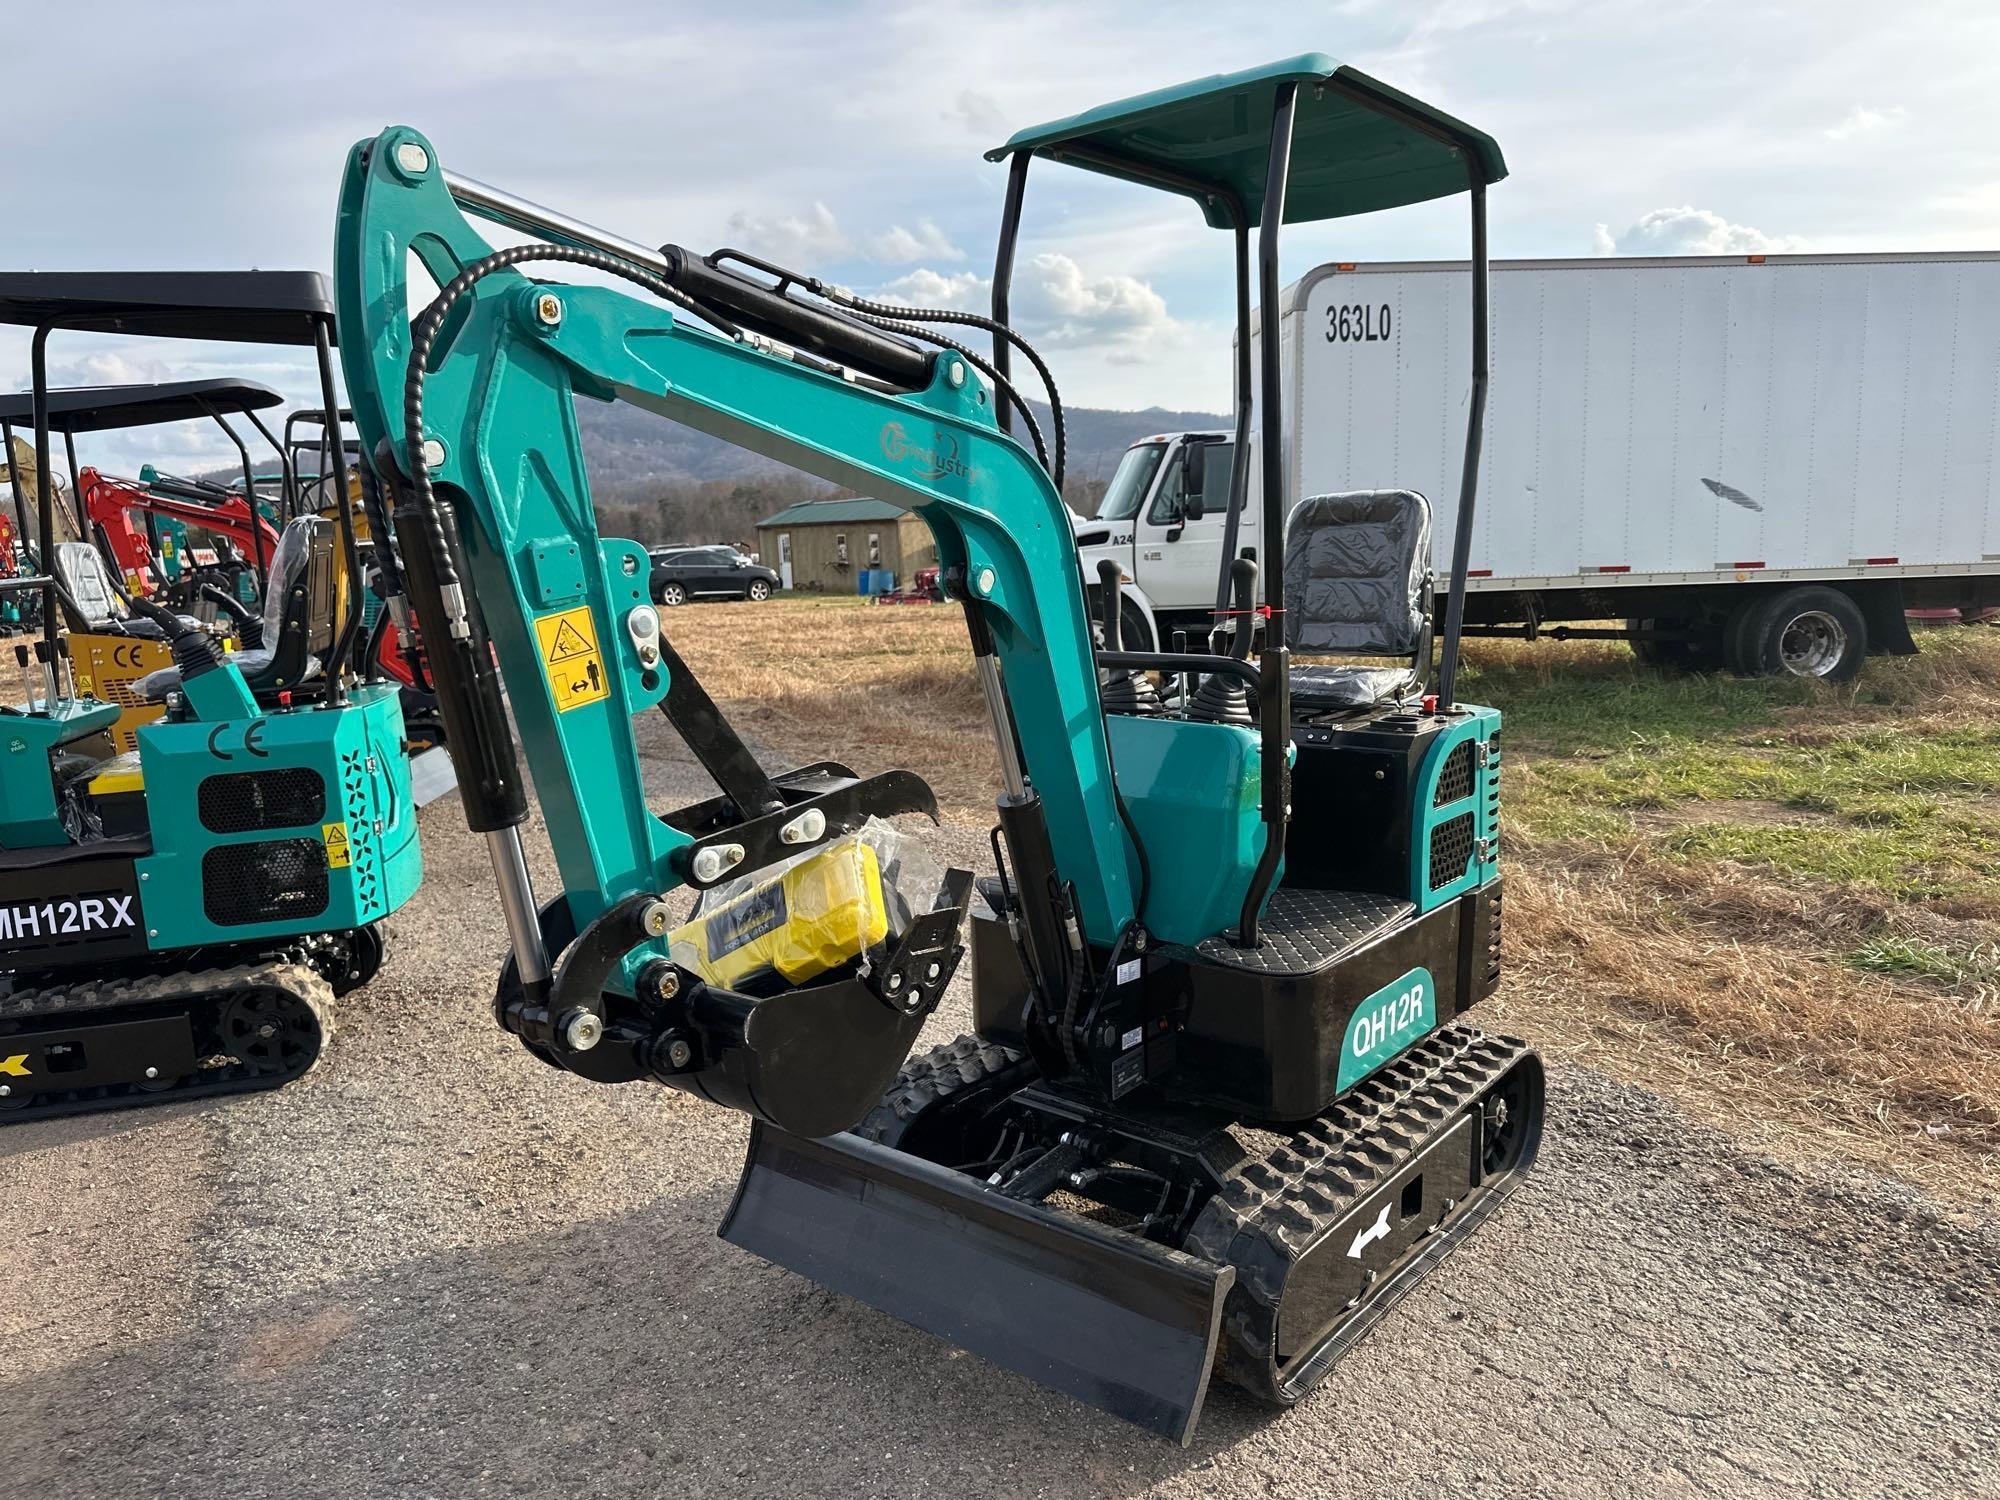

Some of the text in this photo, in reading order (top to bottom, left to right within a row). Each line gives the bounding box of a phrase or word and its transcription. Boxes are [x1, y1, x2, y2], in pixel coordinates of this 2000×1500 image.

[1112, 534, 1134, 546] A24
[208, 720, 269, 761] CE
[1353, 983, 1424, 1058] QH12R
